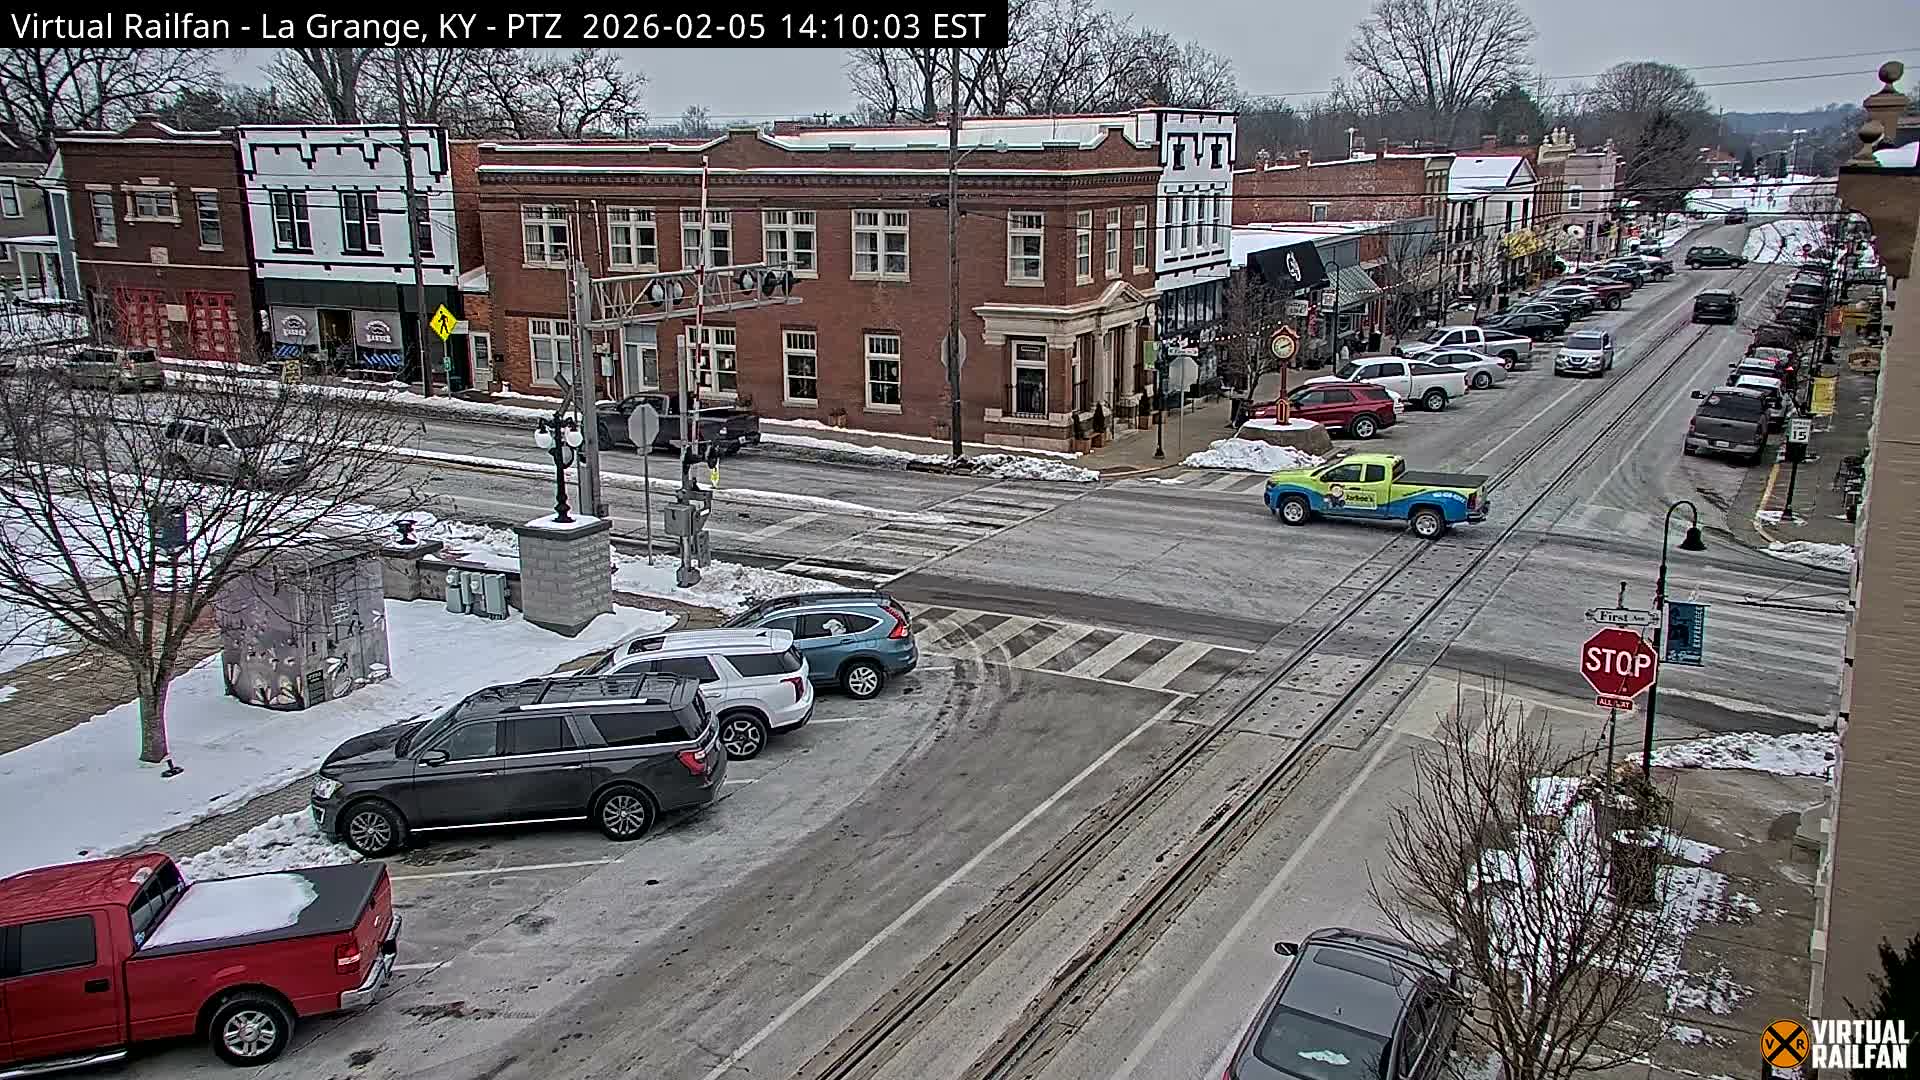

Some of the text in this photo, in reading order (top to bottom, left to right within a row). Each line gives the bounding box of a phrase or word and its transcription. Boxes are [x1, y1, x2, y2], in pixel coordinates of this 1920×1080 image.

[1793, 430, 1807, 441] 15
[1600, 611, 1629, 622] First
[1585, 647, 1651, 678] STOP
